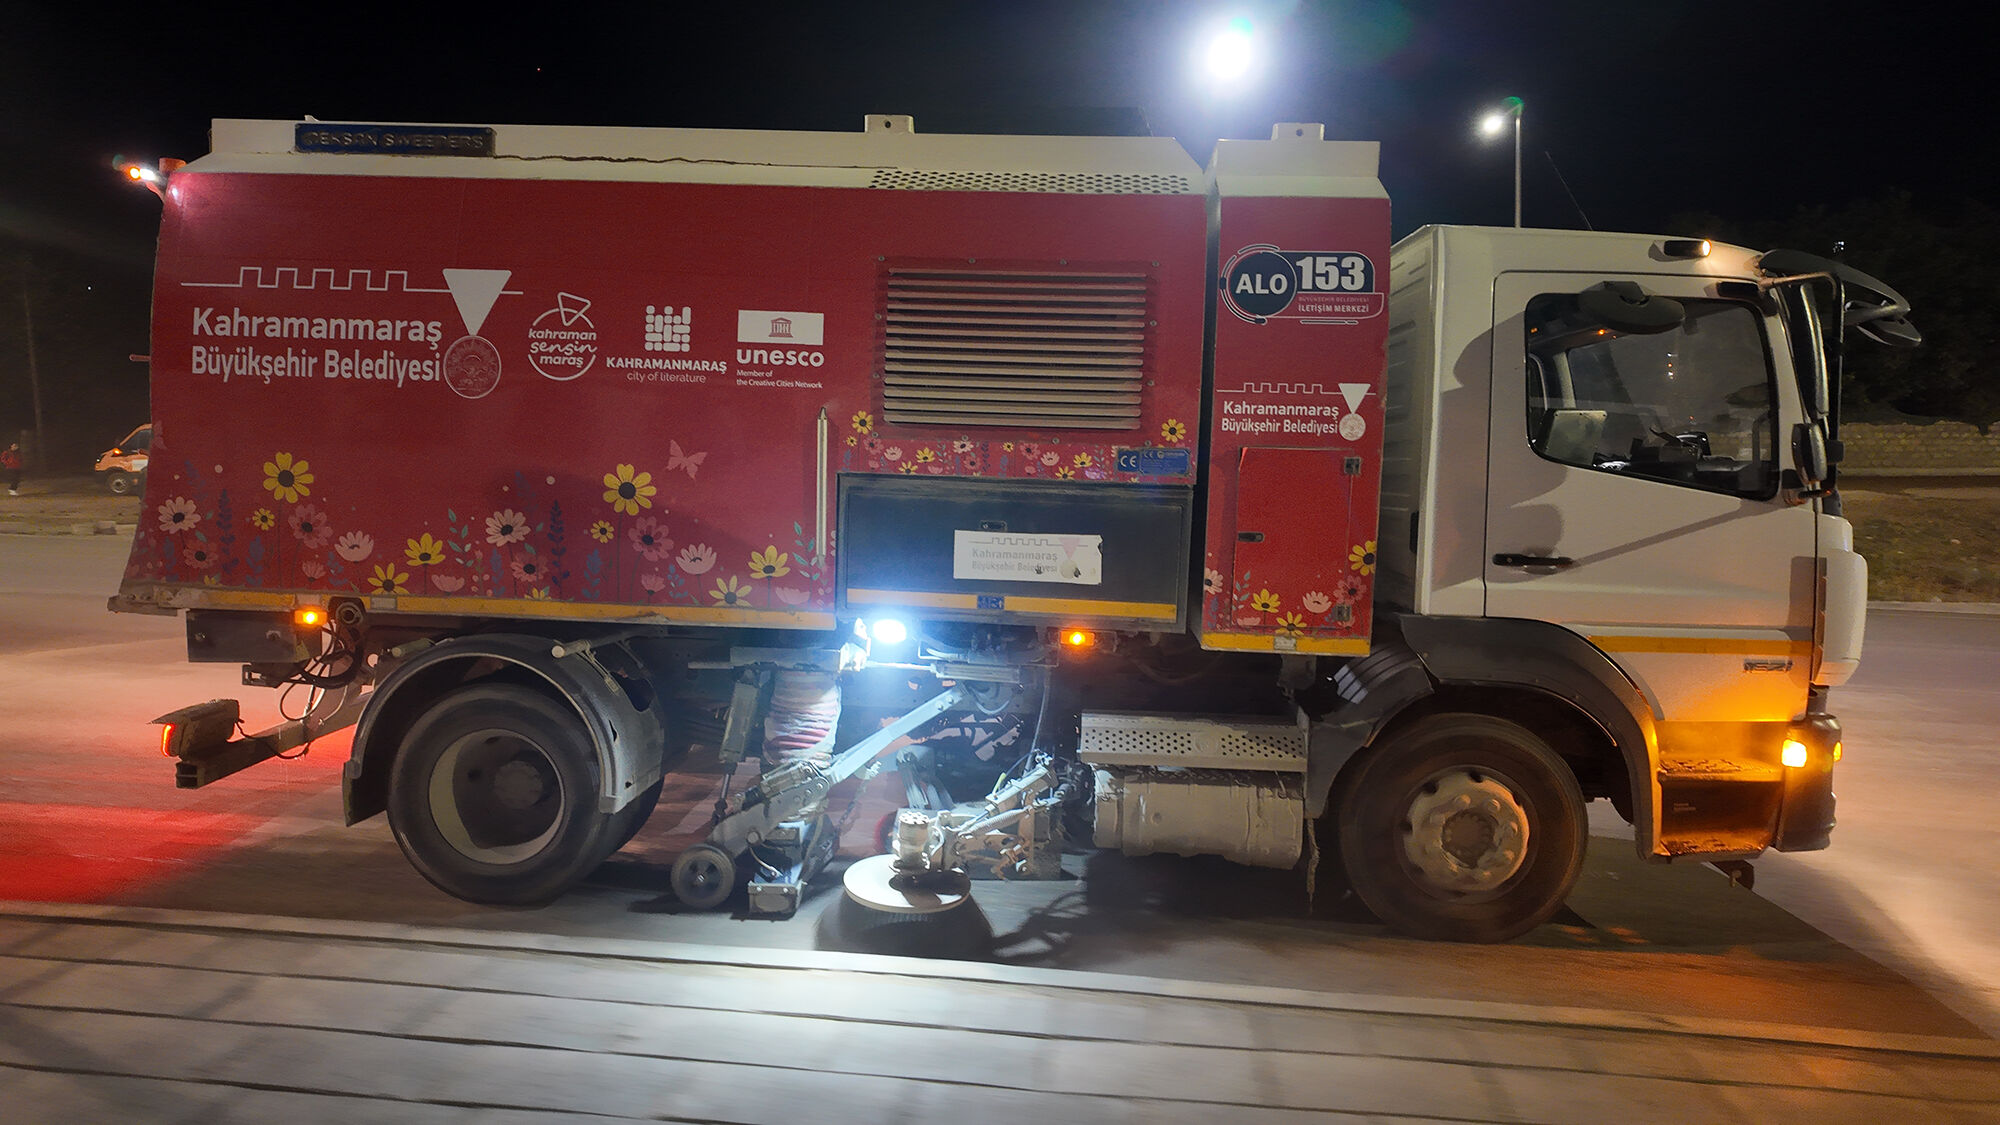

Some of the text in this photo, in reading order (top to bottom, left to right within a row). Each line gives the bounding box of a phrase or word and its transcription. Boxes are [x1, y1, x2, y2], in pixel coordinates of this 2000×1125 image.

[1296, 256, 1366, 291] 153
[1235, 273, 1288, 295] ALO
[1298, 303, 1369, 313] İLETİŞİM MERKEZİ
[193, 307, 442, 350] Kahramanmaraş
[528, 328, 597, 341] kahraman
[530, 341, 598, 356] sensin
[539, 356, 584, 368] maraş
[606, 357, 727, 374] KAHRAMANMARAŞ
[736, 349, 825, 367] unesco
[192, 346, 441, 388] Büyükşehir Belediyesi
[736, 369, 764, 377] Member
[627, 371, 706, 383] city of literature
[748, 379, 775, 387] Creative
[1223, 401, 1340, 419] Kahramanmaraş
[1222, 418, 1338, 436] Büyükşehir Belediyesi
[1120, 455, 1137, 467] CE
[972, 549, 1058, 562] Kahramanmaraş
